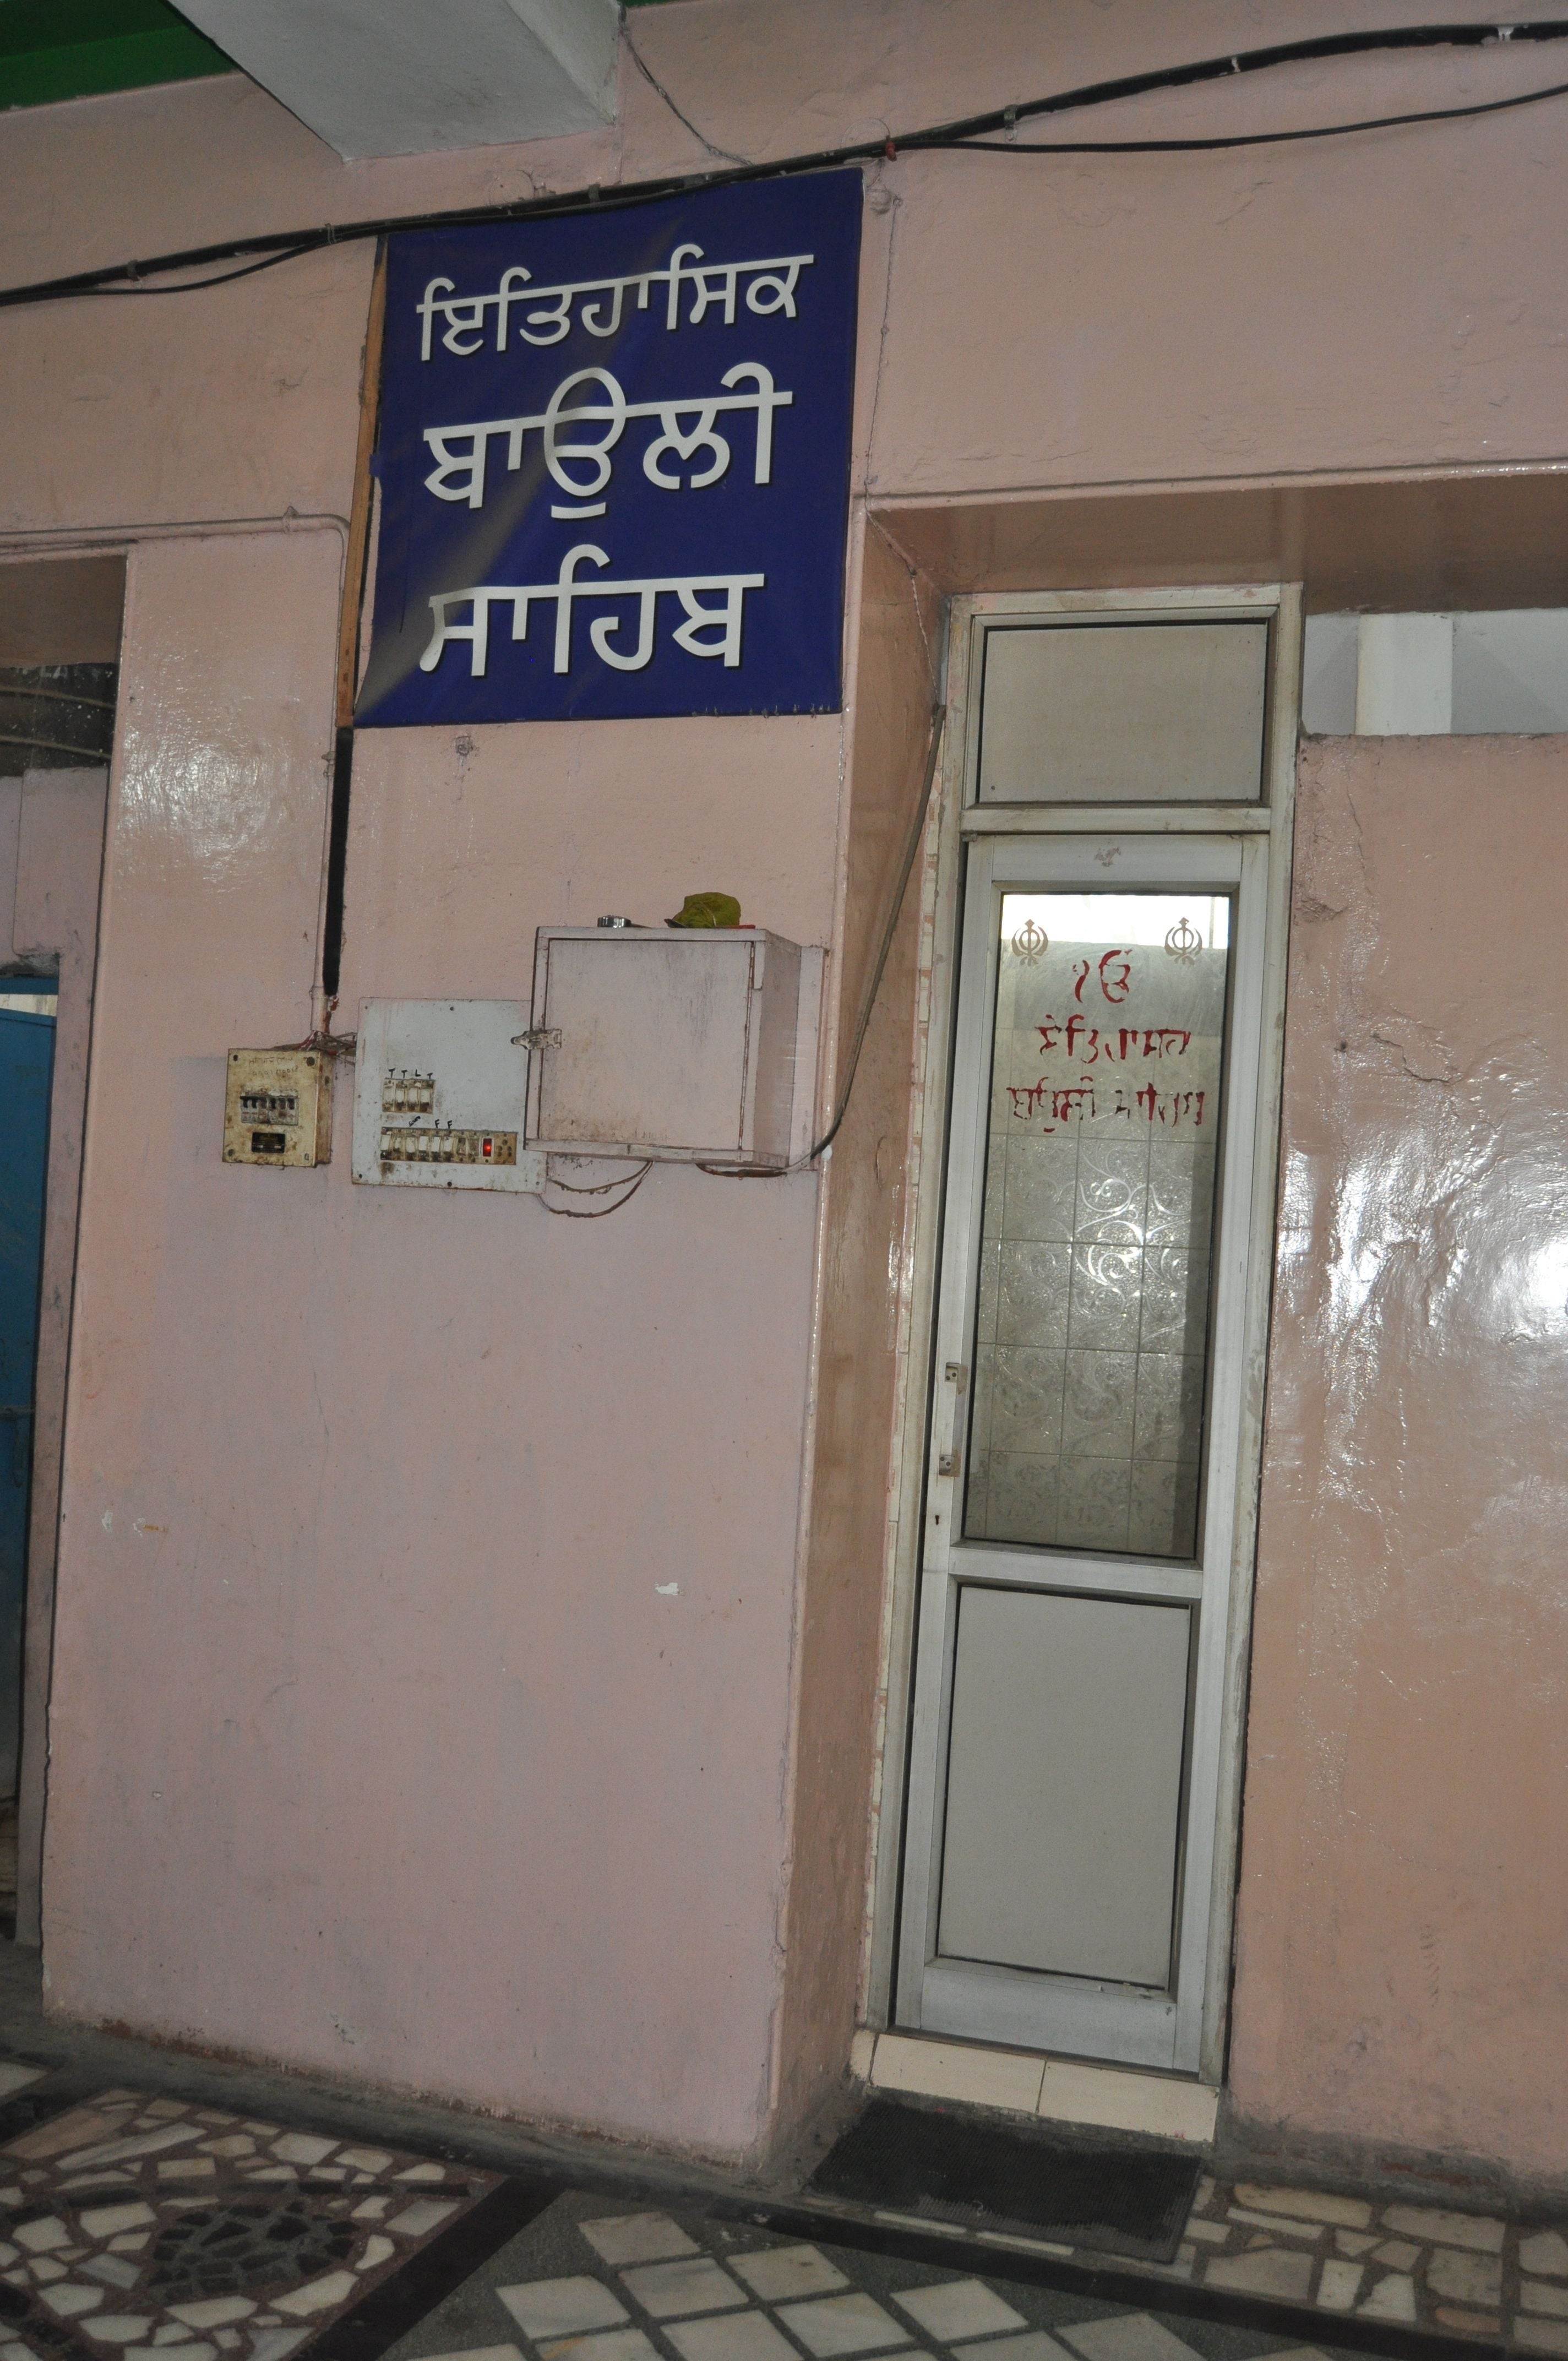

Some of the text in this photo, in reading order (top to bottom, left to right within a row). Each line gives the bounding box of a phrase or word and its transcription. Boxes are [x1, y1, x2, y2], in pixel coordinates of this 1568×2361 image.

[416, 243, 815, 361] ਇਤਿਹਾਸਿਕ
[422, 361, 793, 519] ਬਾਉਲੀ
[418, 543, 766, 677] ਸਾਹਿਬ
